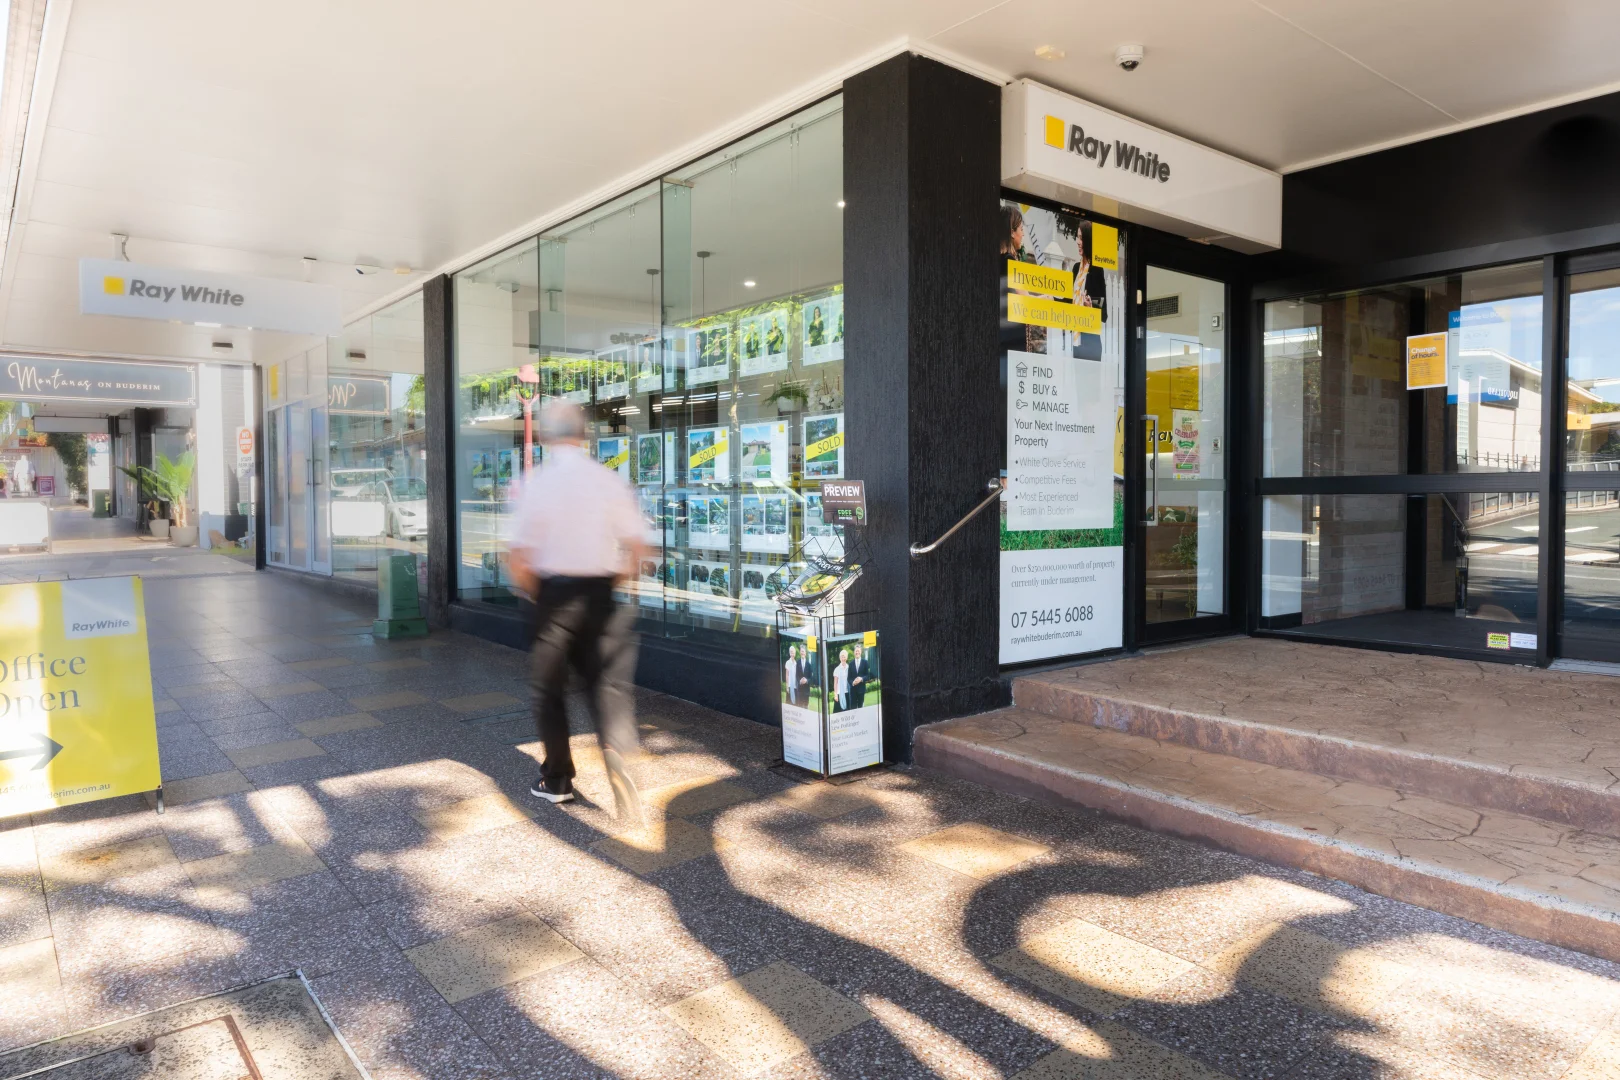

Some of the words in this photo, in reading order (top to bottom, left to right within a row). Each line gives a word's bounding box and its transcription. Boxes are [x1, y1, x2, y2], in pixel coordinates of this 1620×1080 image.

[1067, 123, 1112, 169] Ray
[1114, 139, 1171, 184] White
[1013, 267, 1066, 293] Investors
[129, 279, 177, 303] Ray
[181, 284, 245, 307] White
[1013, 302, 1028, 318] We
[1031, 308, 1048, 321] can
[1050, 307, 1071, 327] help
[1073, 313, 1095, 328] you?
[1411, 346, 1437, 355] Change
[7, 362, 92, 392] Montanas
[98, 381, 112, 389] ON
[116, 382, 161, 391] BUDERIM
[1032, 366, 1053, 379] FIND
[1032, 383, 1050, 395] BUY
[1052, 385, 1058, 397] &
[1032, 400, 1070, 414] MANAGE
[1014, 418, 1033, 430] Your
[1035, 419, 1053, 432] Next
[1055, 421, 1095, 434] Investment
[817, 435, 841, 454] SOLD
[1014, 434, 1049, 448] Property
[699, 446, 717, 463] SOLD
[1019, 457, 1041, 468] White
[1042, 457, 1062, 469] Glove
[1063, 458, 1086, 469] Service
[1019, 474, 1060, 487] Competitive
[1061, 475, 1077, 485] Fees
[824, 485, 860, 497] PREVIEW
[1019, 491, 1037, 502] Most
[1039, 491, 1079, 504] Experienced
[1019, 505, 1038, 516] Team
[1047, 505, 1075, 516] Buderim
[815, 557, 843, 572] PREVEW
[1011, 564, 1026, 574] Over
[1068, 560, 1085, 571] worth
[1085, 560, 1092, 570] of
[1092, 559, 1116, 571] property
[1011, 577, 1040, 588] currently
[1040, 576, 1059, 586] under
[1059, 574, 1097, 585] management.
[1011, 612, 1027, 629] 07
[1031, 608, 1061, 627] 5445
[1064, 604, 1094, 623] 6088
[72, 619, 130, 632] RayWhite
[1011, 630, 1083, 645] raywhitebuderim.com.au
